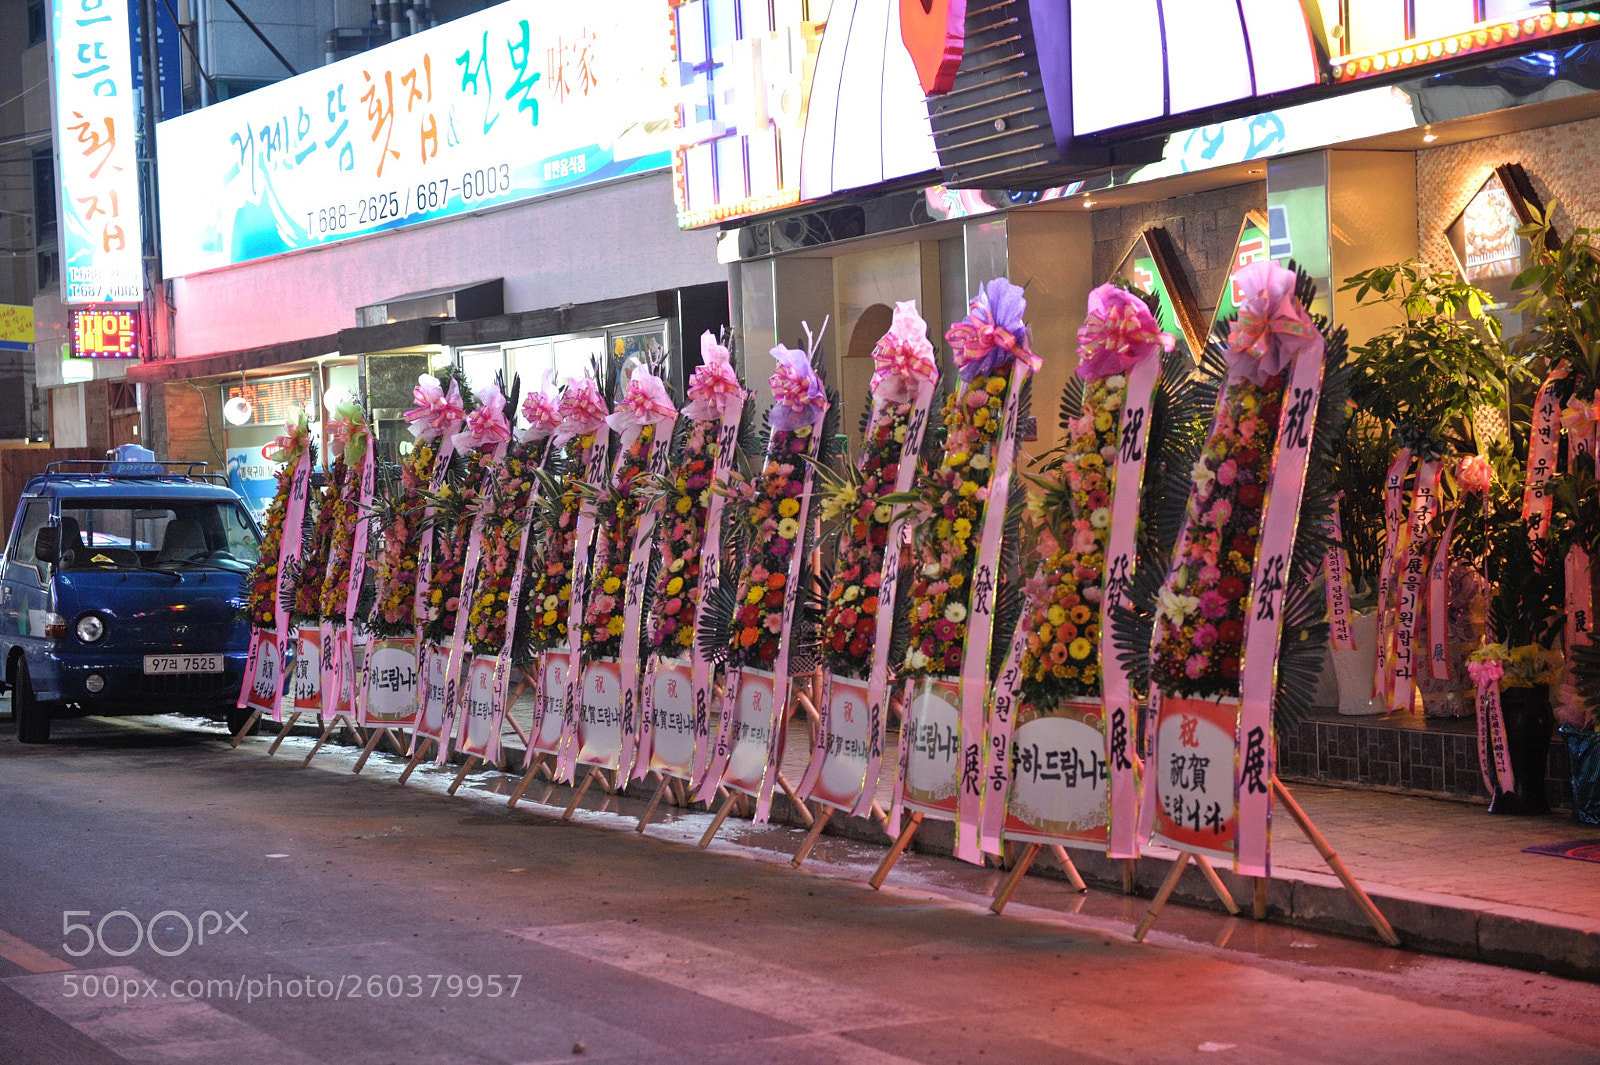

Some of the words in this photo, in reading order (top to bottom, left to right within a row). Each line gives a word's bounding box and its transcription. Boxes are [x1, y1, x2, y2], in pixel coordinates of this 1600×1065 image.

[360, 53, 438, 177] 횟집
[447, 104, 460, 148] &
[455, 19, 541, 135] 전복
[67, 111, 125, 253] 횟집
[306, 191, 399, 238] T.688-2625
[417, 164, 511, 211] 687-6003
[720, 425, 735, 469] 祝
[1120, 407, 1145, 464] 祝
[1283, 387, 1314, 450] 祝
[184, 657, 216, 671] 7525
[1109, 707, 1133, 772] 展
[1178, 713, 1200, 748] 祝
[1240, 725, 1267, 795] 展
[961, 744, 981, 797] 展
[989, 733, 1008, 792] 일동
[1169, 752, 1211, 794] 祝賀
